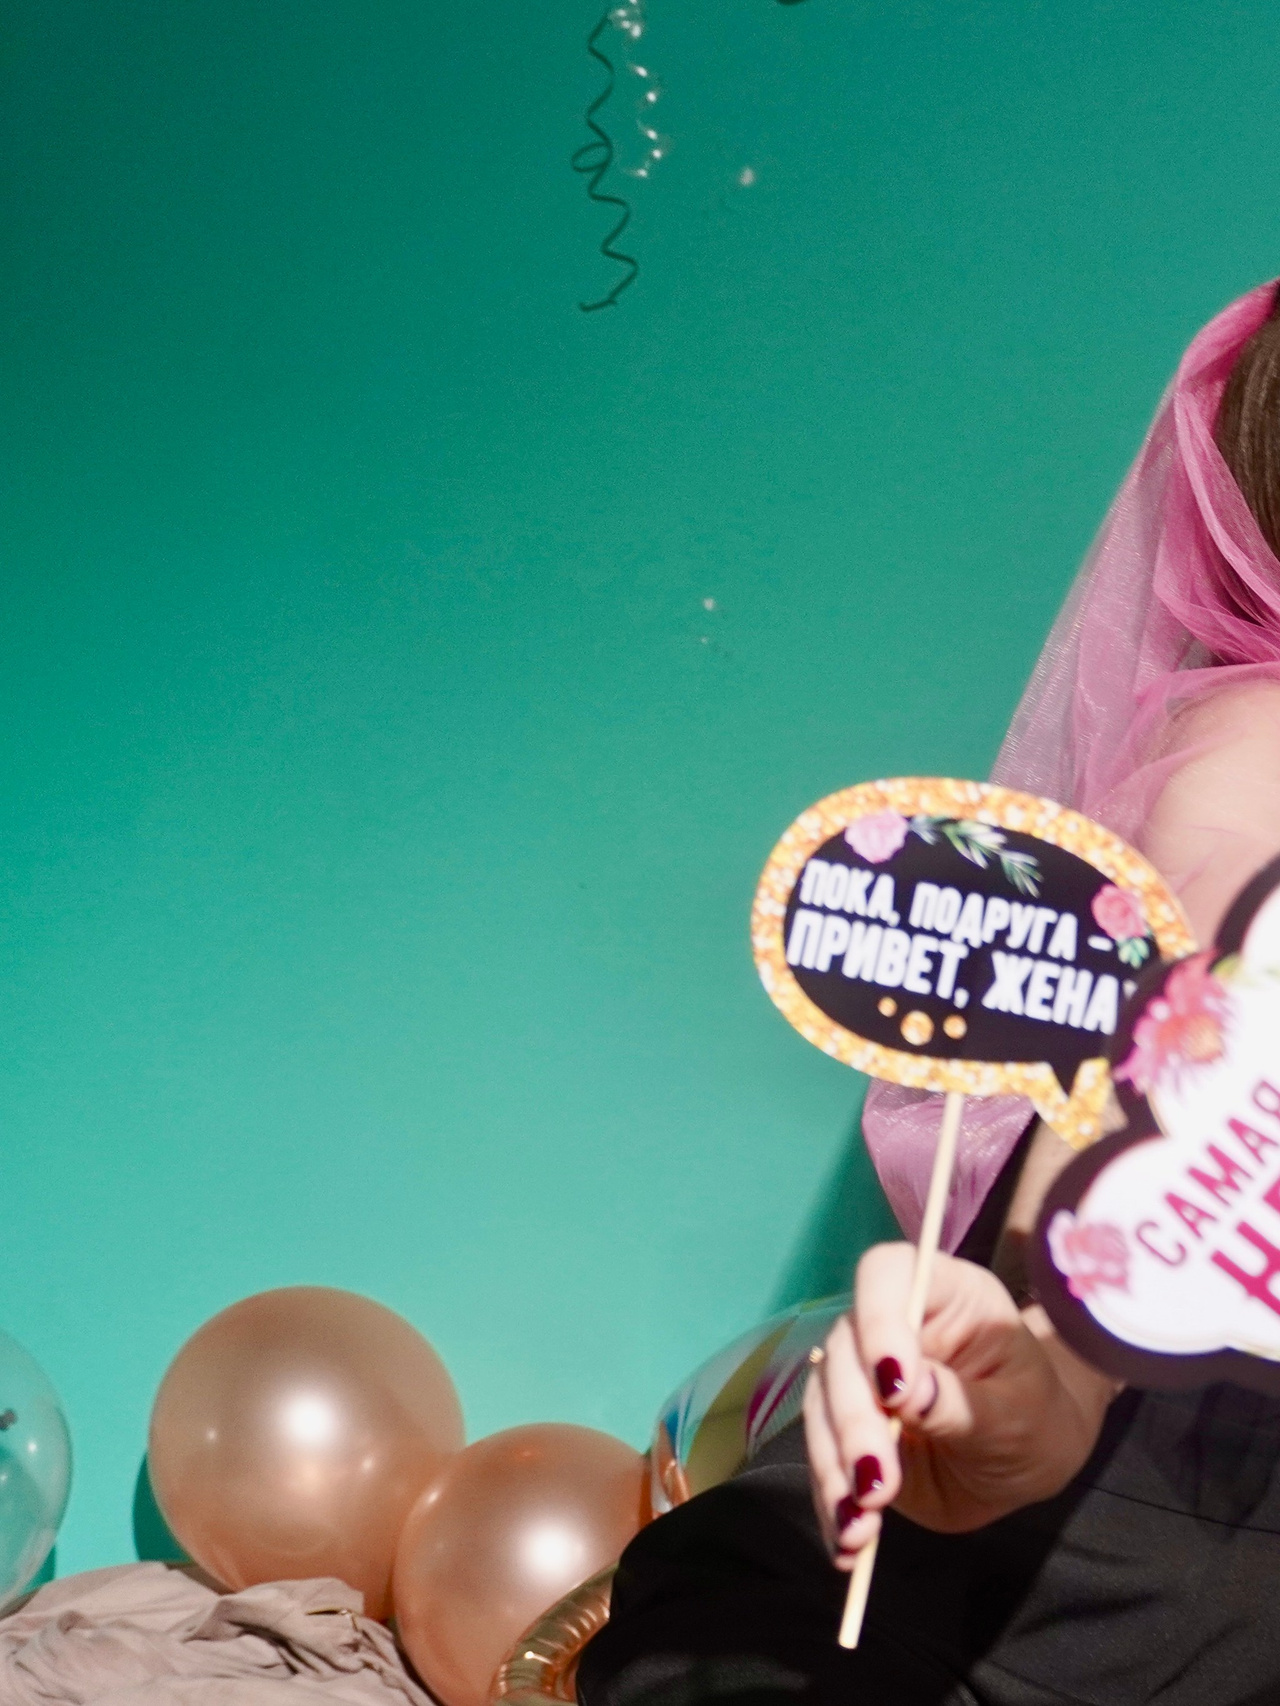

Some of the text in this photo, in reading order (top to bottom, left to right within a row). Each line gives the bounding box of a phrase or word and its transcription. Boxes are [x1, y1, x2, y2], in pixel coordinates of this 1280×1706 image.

[786, 909, 969, 1008] ПРИВЕТ,
[800, 859, 901, 925] ПОКА,
[909, 882, 1078, 960] ПОДРУГА
